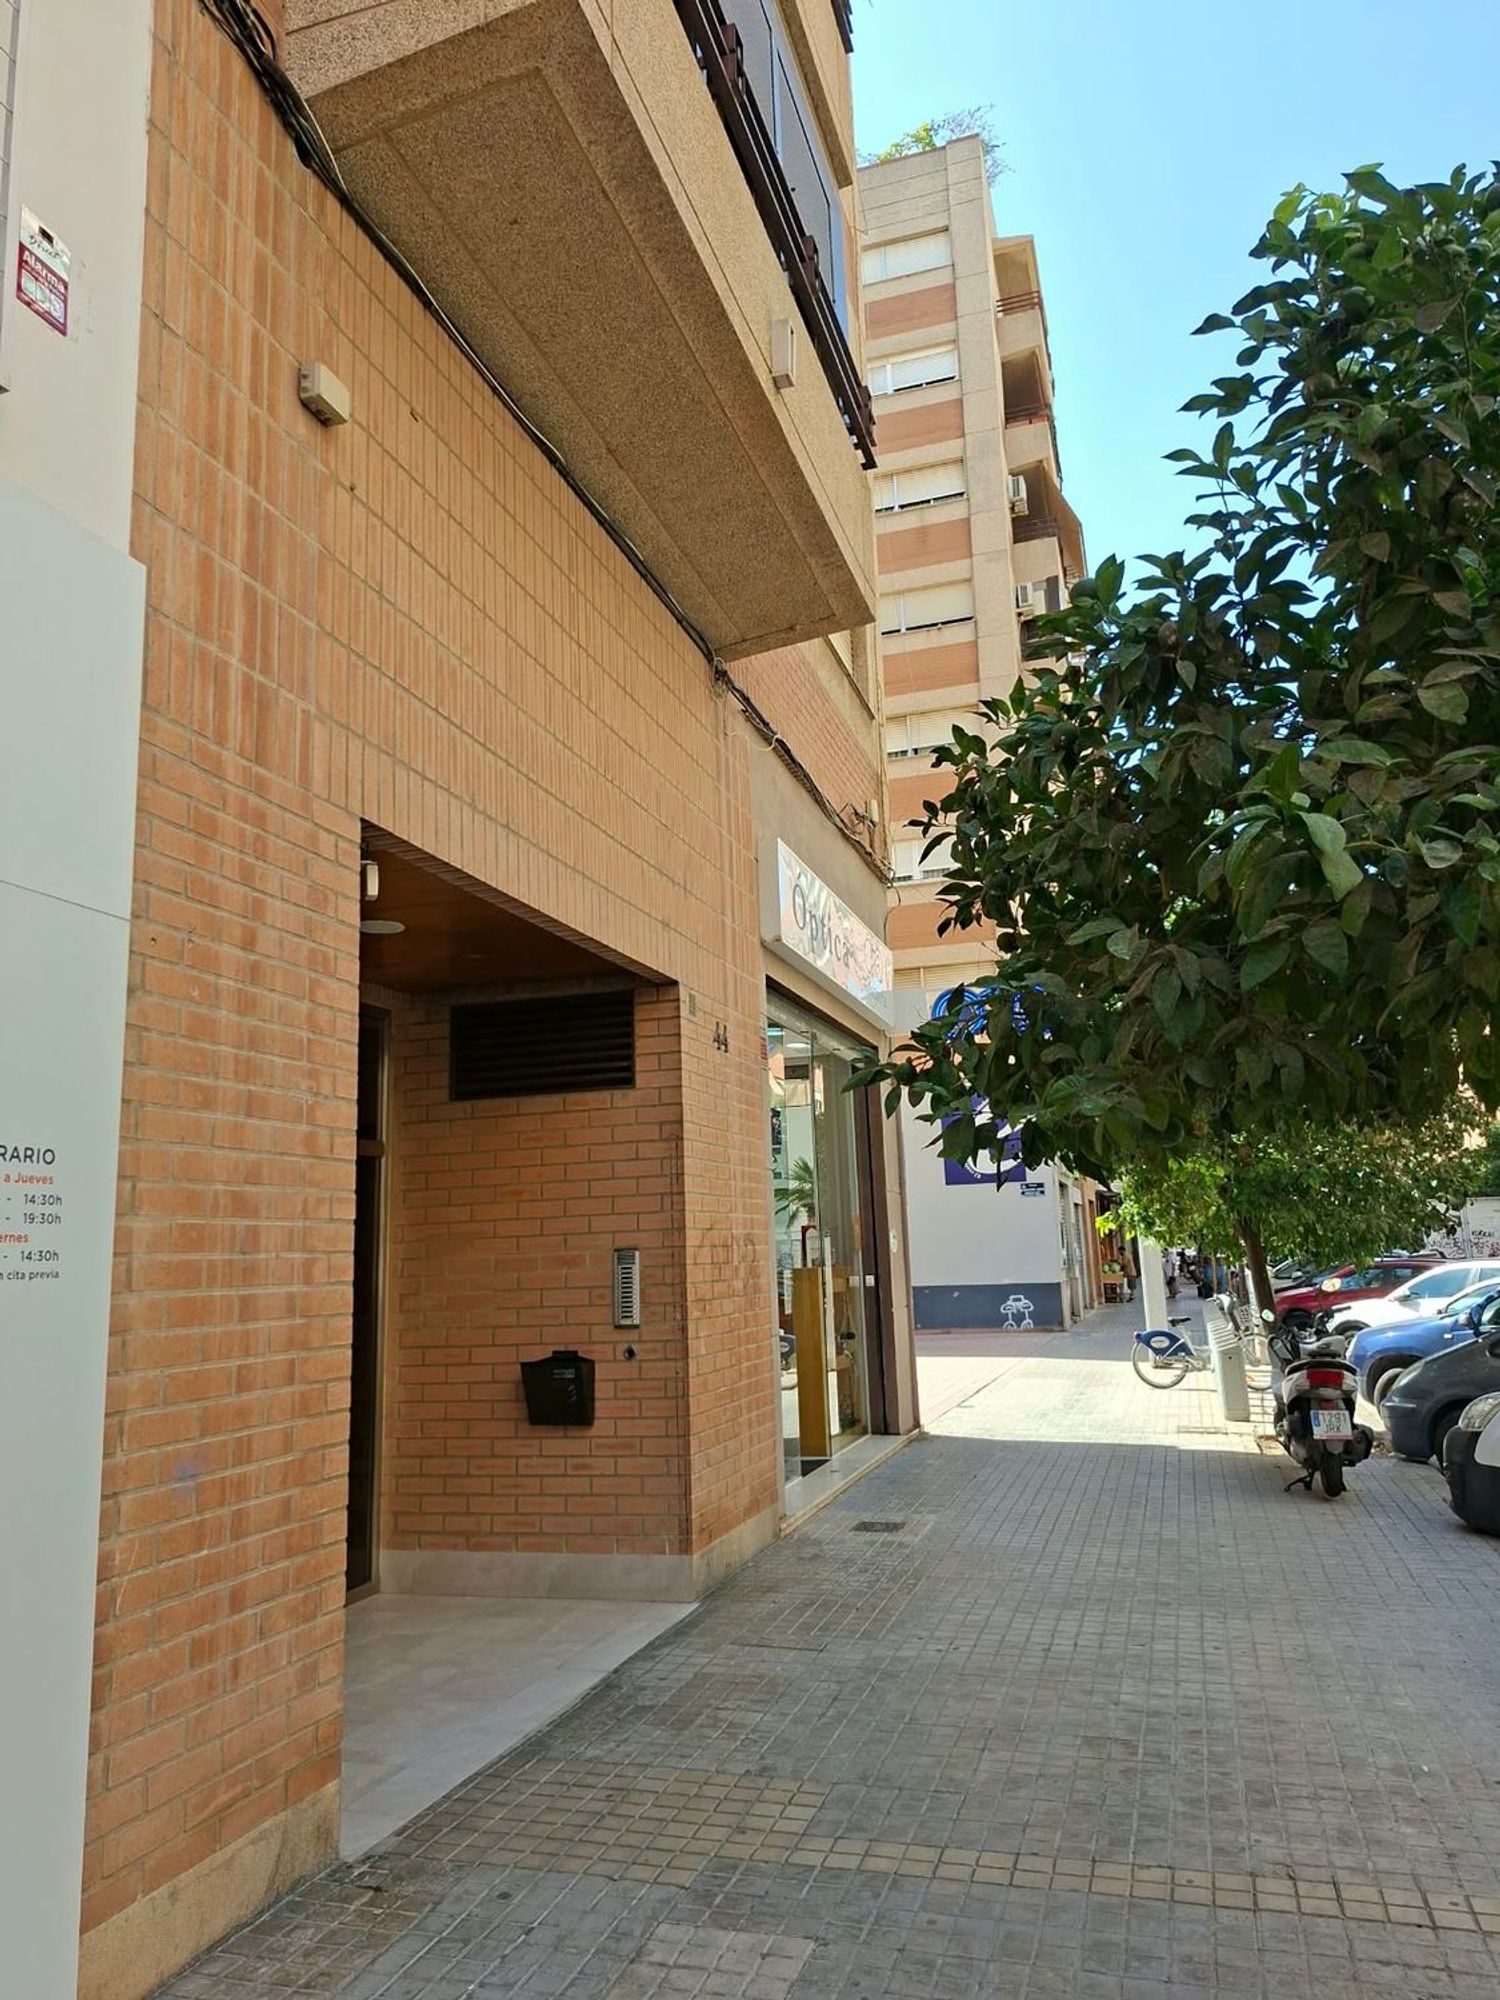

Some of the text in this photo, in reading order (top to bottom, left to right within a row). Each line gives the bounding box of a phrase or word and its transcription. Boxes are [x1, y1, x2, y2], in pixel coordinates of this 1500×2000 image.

[711, 1020, 729, 1053] 44
[4, 1172, 54, 1185] a Jueves
[24, 1193, 63, 1206] 14:30h
[23, 1213, 62, 1225] 19:30h
[21, 1250, 59, 1262] 14:30h
[7, 1270, 26, 1280] cita
[28, 1269, 60, 1282] previa
